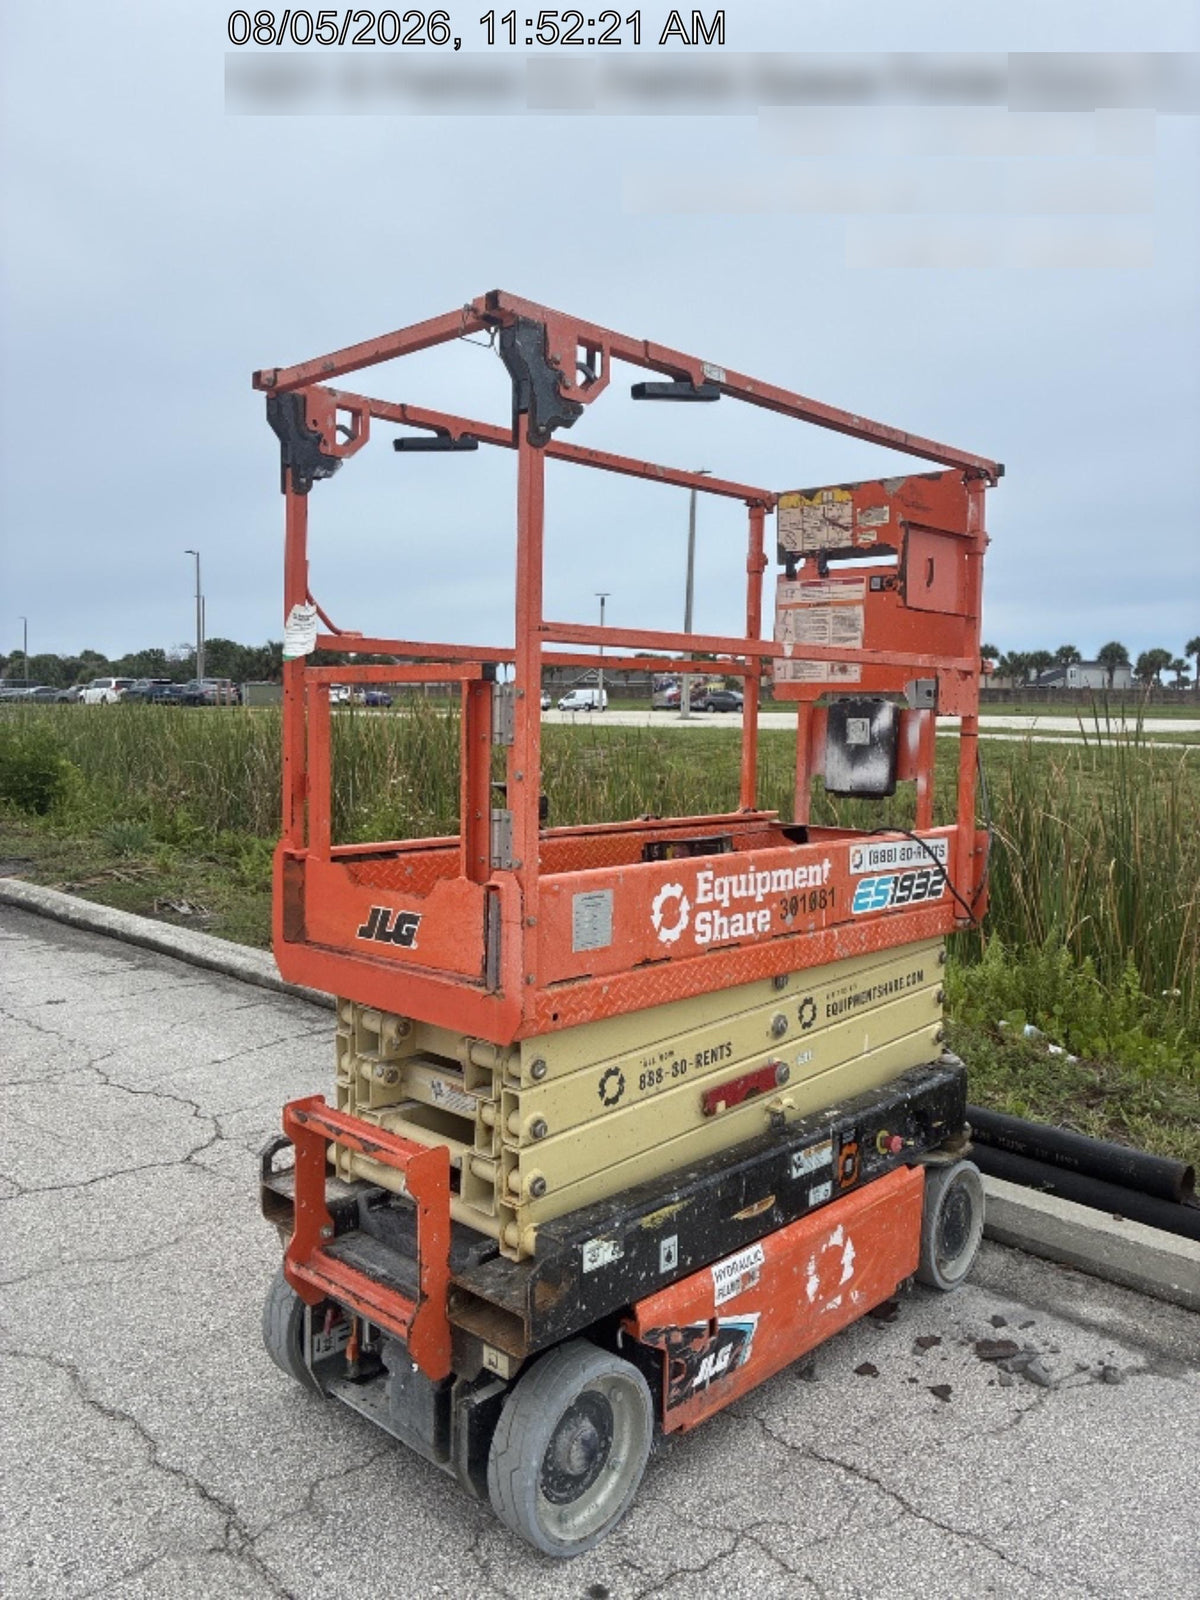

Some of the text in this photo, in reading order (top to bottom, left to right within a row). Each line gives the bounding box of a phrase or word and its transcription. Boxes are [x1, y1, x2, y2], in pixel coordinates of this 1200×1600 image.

[695, 858, 832, 907] Equipment
[779, 887, 836, 920] 301081
[852, 866, 948, 914] ES1932
[356, 905, 422, 949] JLG
[694, 908, 772, 945] Share
[639, 1041, 732, 1091] 888-80-RENTS
[691, 1341, 733, 1387] JLG
